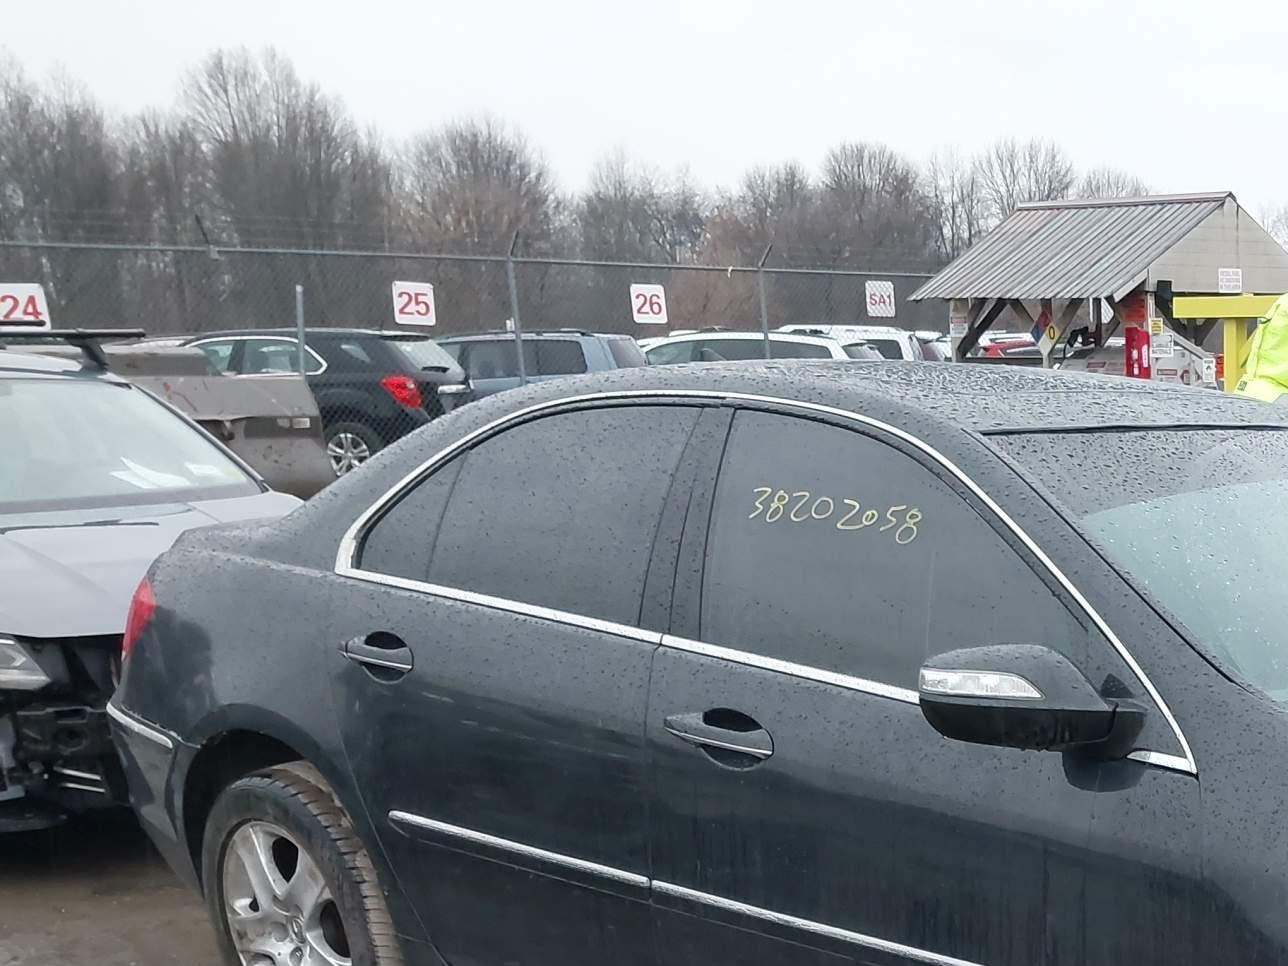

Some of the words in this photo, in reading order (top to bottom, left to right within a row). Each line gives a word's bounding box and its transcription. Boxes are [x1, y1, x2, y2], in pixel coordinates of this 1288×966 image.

[0, 294, 43, 320] 24
[398, 291, 431, 317] 25
[635, 293, 662, 316] 26
[748, 486, 922, 545] 38202058
